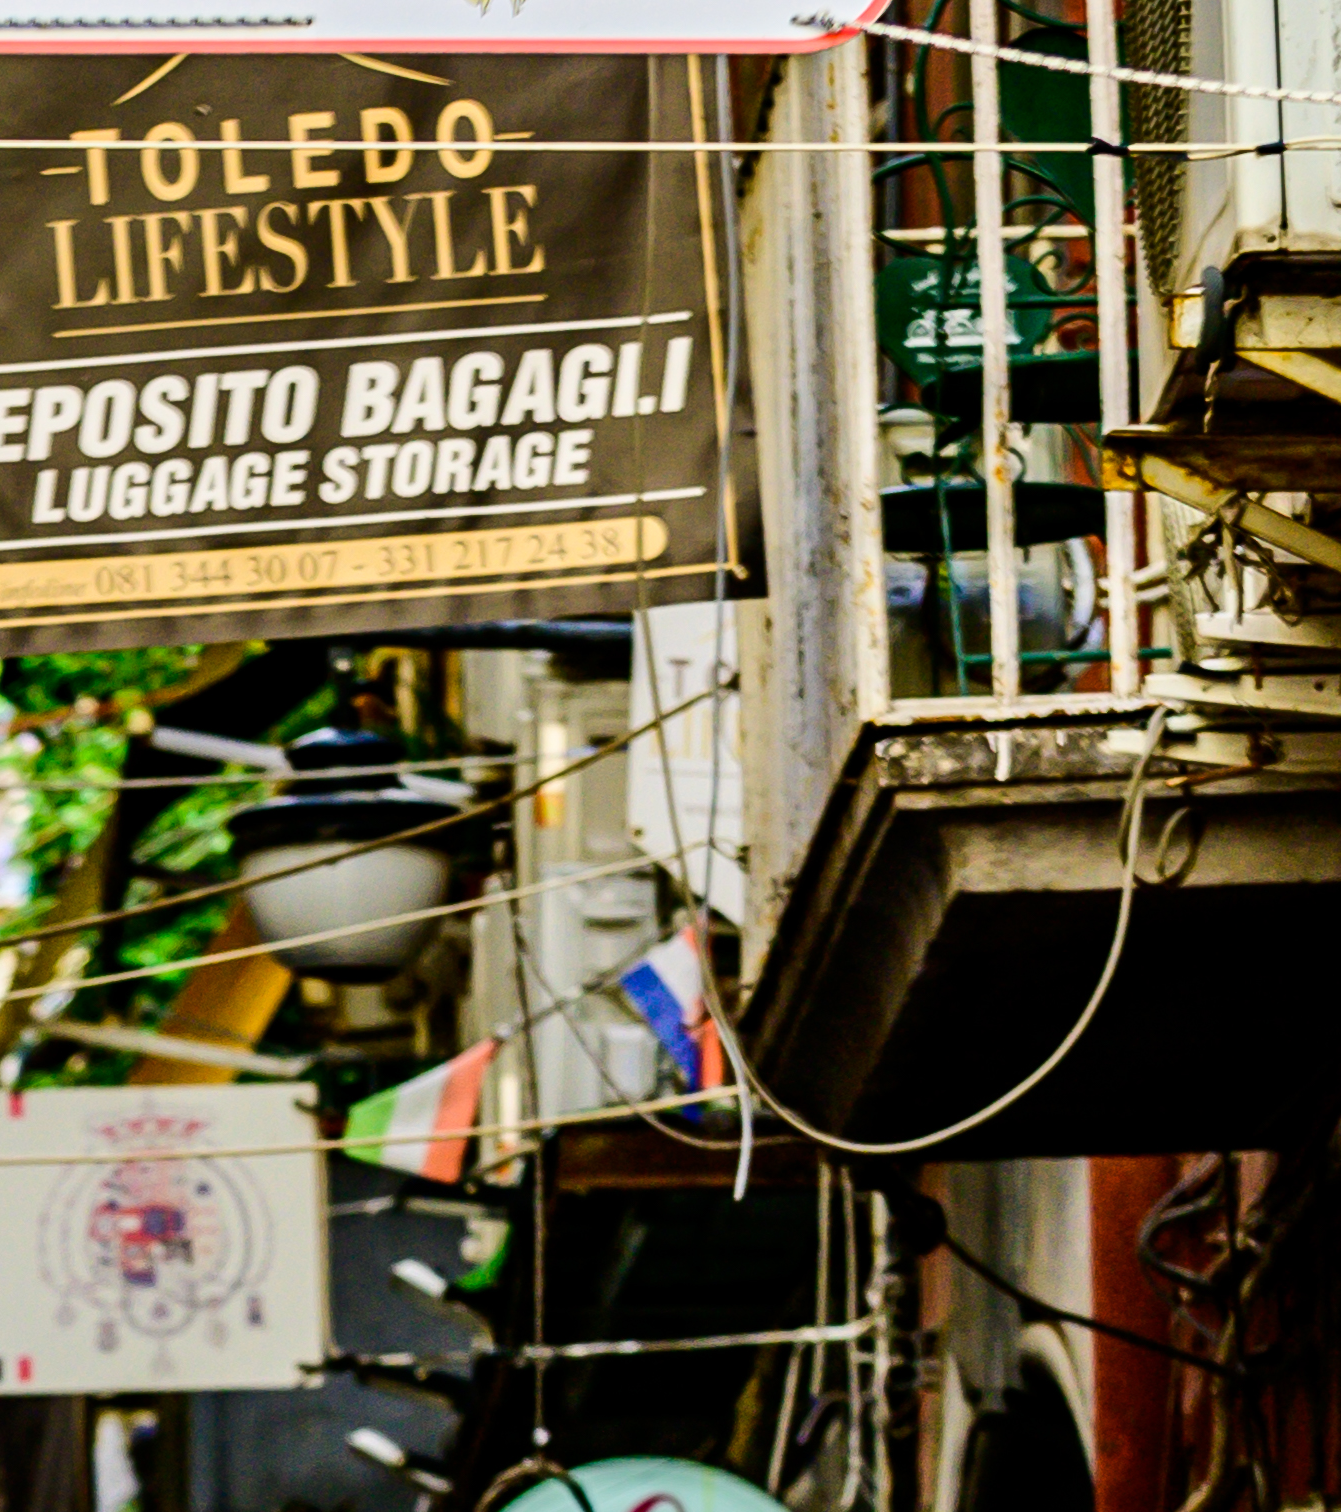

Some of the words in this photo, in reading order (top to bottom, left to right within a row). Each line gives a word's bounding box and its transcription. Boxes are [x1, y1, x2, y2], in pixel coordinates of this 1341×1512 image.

[74, 98, 497, 205] TOLEDO
[45, 184, 547, 310] LIFESTYLE
[339, 336, 694, 439] BAGAGLI
[30, 450, 310, 525] LUGGAGE
[318, 430, 594, 503] STORAGE
[94, 564, 154, 597] 081
[170, 560, 232, 592] 344
[245, 555, 287, 586] 30
[298, 550, 339, 582] 07
[376, 543, 438, 577] 331
[452, 537, 513, 569] 217
[524, 533, 568, 563] 24
[579, 529, 621, 560] 38
